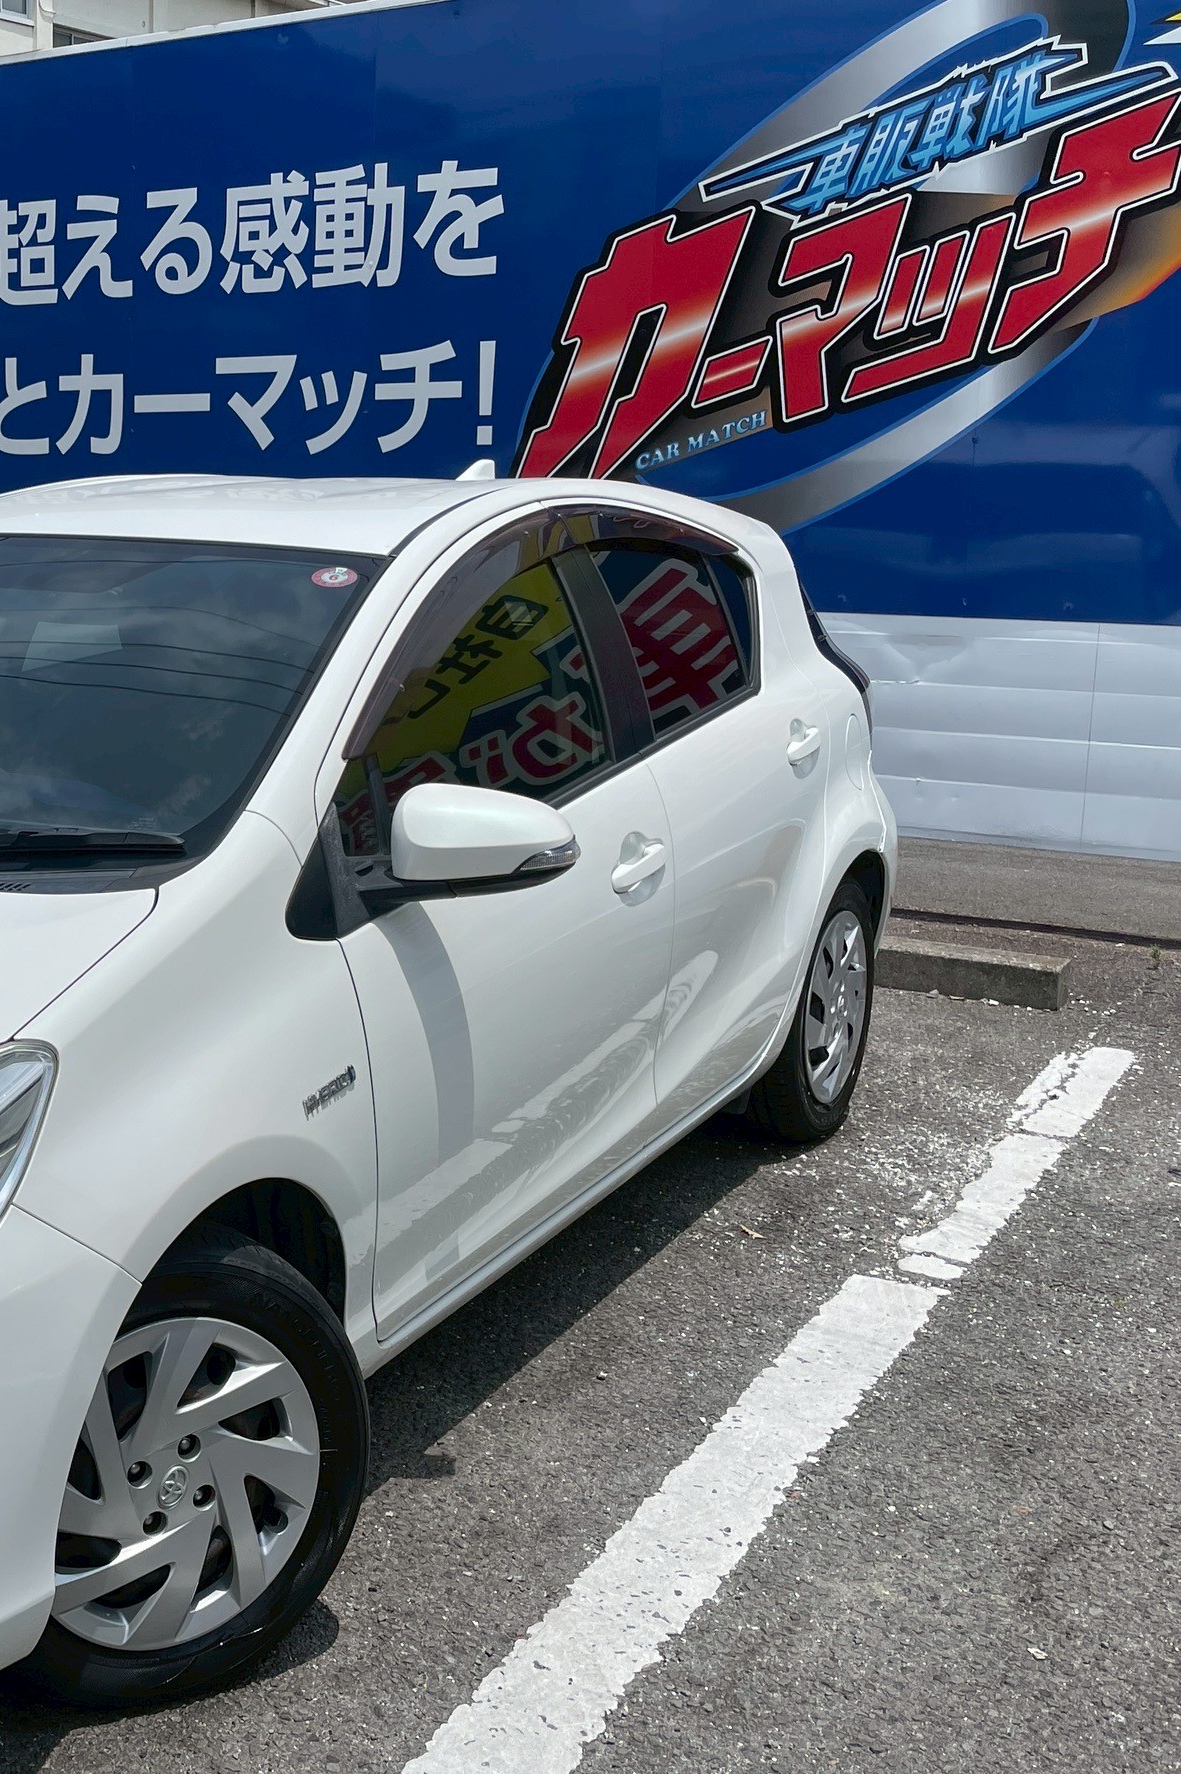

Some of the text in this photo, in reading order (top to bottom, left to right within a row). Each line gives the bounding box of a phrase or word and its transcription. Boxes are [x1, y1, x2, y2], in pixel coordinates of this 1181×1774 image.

[517, 92, 1181, 478] カーマッチ
[635, 410, 767, 471] CAR MATCH
